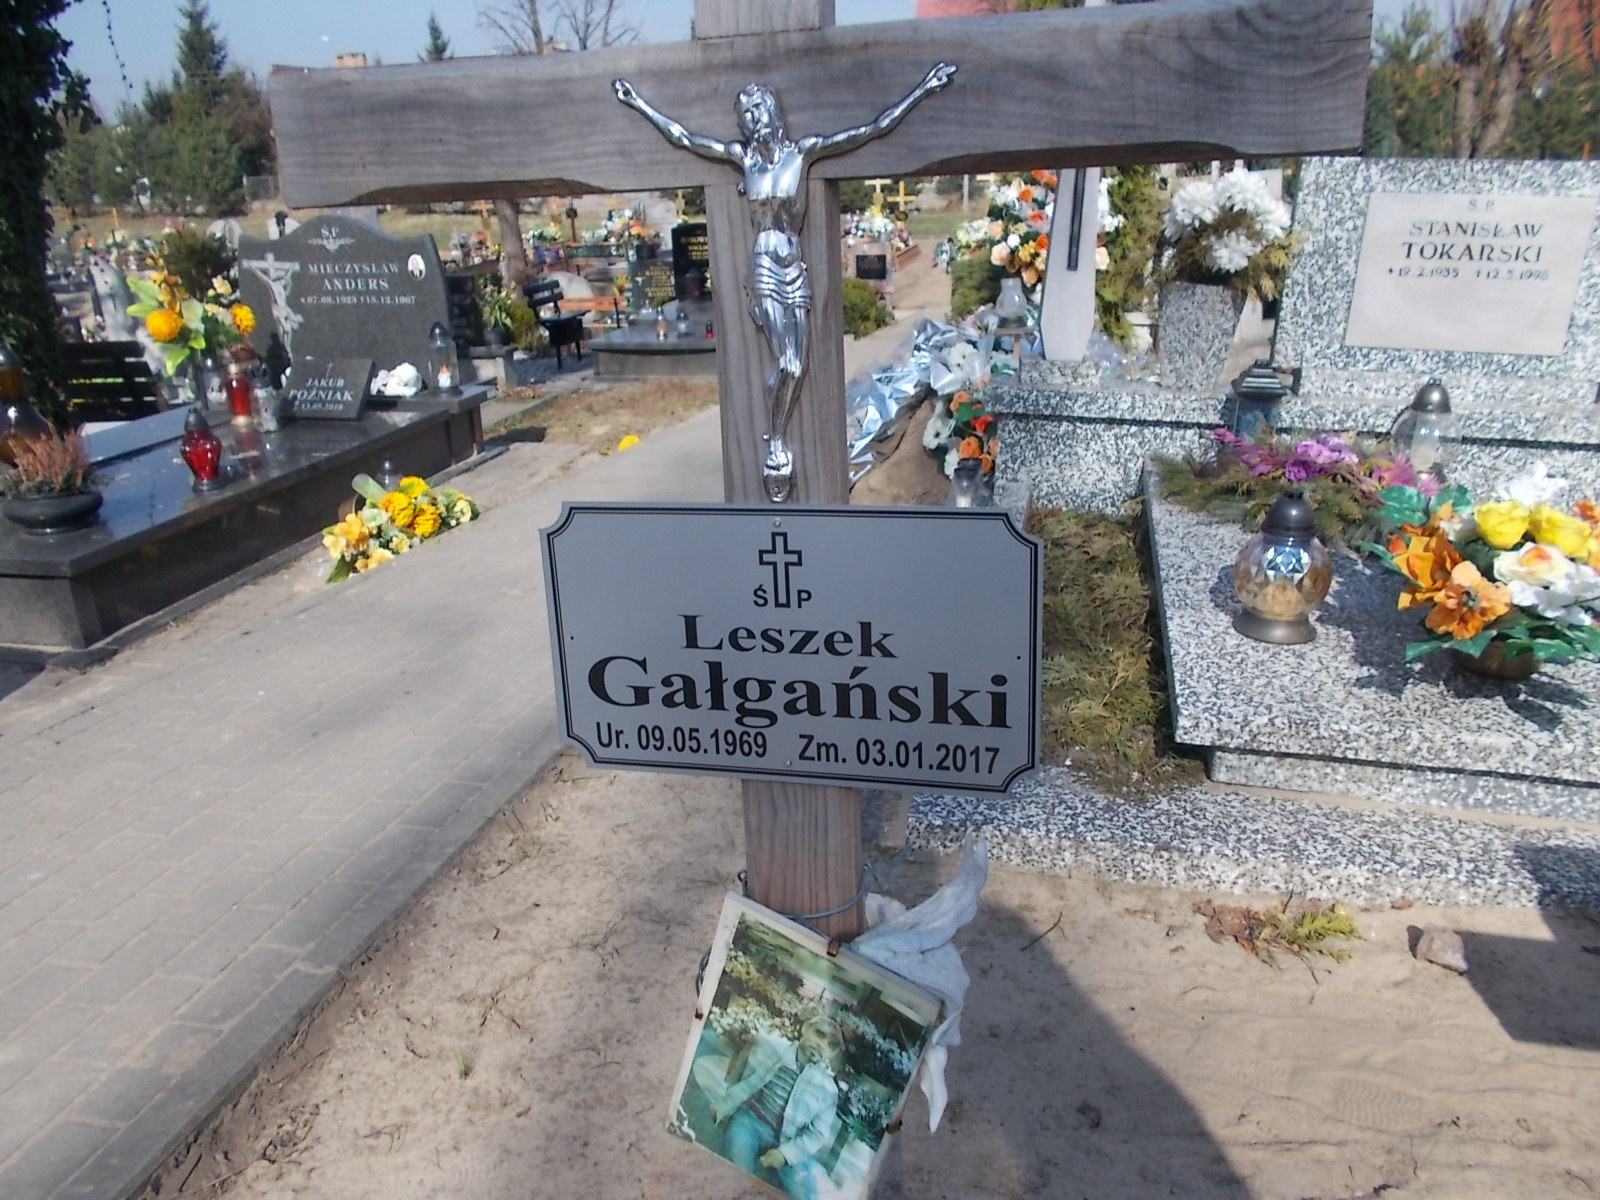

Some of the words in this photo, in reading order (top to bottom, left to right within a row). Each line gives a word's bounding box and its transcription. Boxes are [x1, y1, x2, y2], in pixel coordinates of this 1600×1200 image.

[1409, 220, 1544, 238] STANISŁAW
[1402, 241, 1543, 263] TOKARSKI
[323, 278, 389, 291] ANDERS
[305, 377, 345, 388] JAKUB
[796, 589, 813, 609] P
[677, 614, 898, 659] Leszek
[587, 655, 1013, 730] Gałgański
[596, 721, 630, 751] Ur.
[637, 724, 768, 758] 09.05.1969
[798, 734, 847, 765] Zm.
[856, 737, 1000, 775] 03.01.2017
